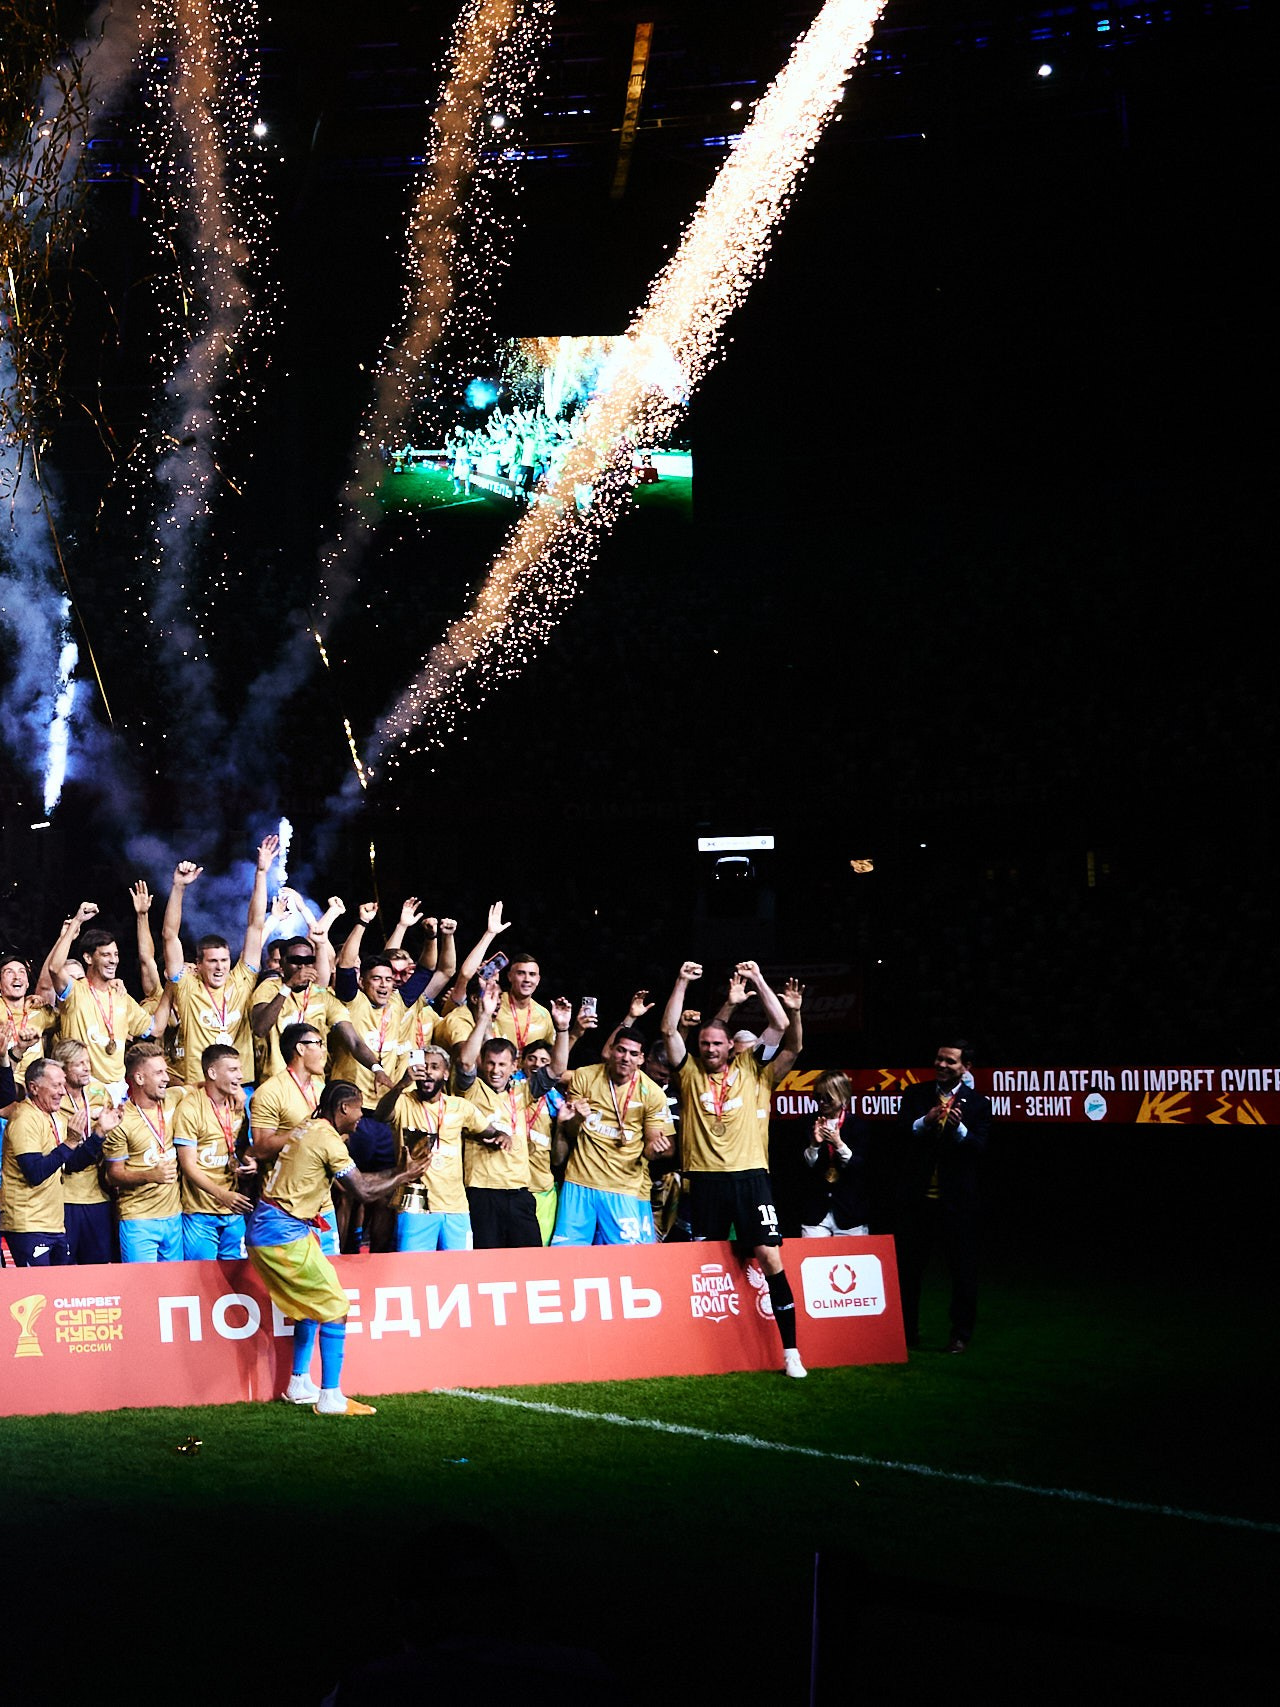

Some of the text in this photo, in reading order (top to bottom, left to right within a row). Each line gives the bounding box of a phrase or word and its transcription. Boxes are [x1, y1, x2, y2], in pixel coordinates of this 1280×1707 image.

[776, 1095, 858, 1115] OLIMT
[1025, 1095, 1072, 1116] ЗЕНИТ
[691, 1272, 736, 1294] БИТВА
[54, 1296, 121, 1309] OLIMPBET
[690, 1293, 740, 1318] ВОЛГЕ
[813, 1297, 878, 1309] OLIMPBET
[54, 1307, 122, 1326] СУПЕР
[55, 1325, 123, 1344] КУБОК
[68, 1342, 112, 1354] РОССИИ
